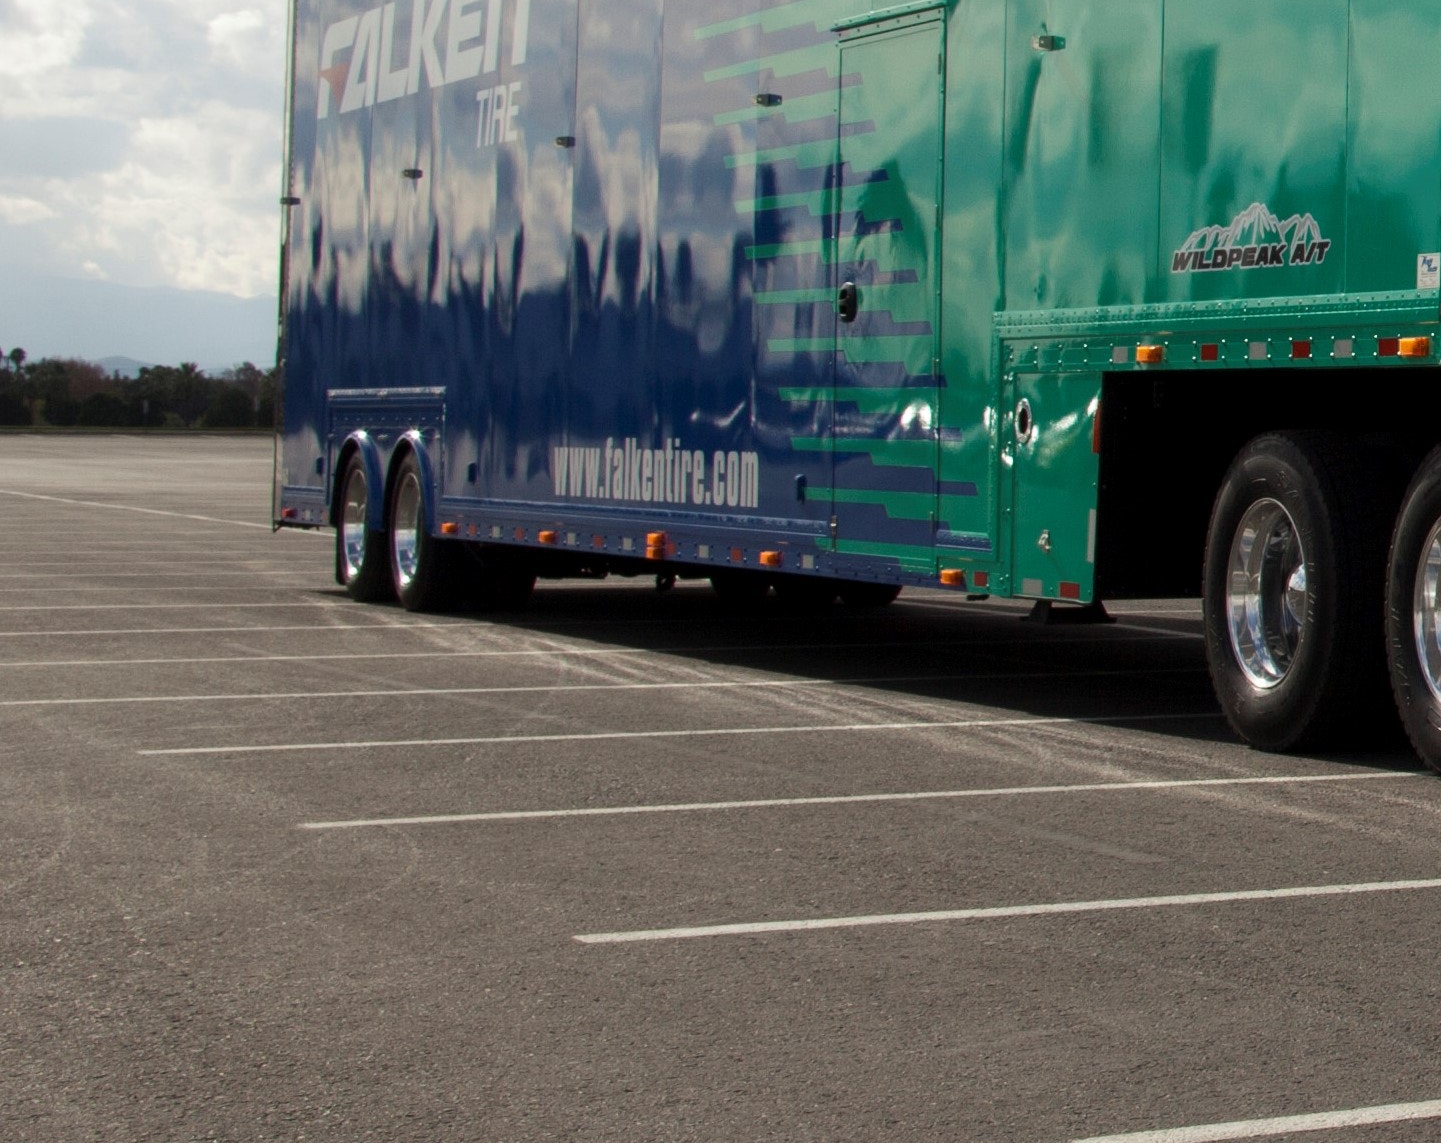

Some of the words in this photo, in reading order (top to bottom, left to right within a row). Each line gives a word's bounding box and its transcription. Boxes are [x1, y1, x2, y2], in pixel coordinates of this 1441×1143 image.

[476, 81, 522, 149] TIRE
[1171, 243, 1288, 272] WILDPEAK
[1290, 240, 1331, 265] A/T
[554, 436, 759, 508] www.falkentire.com
